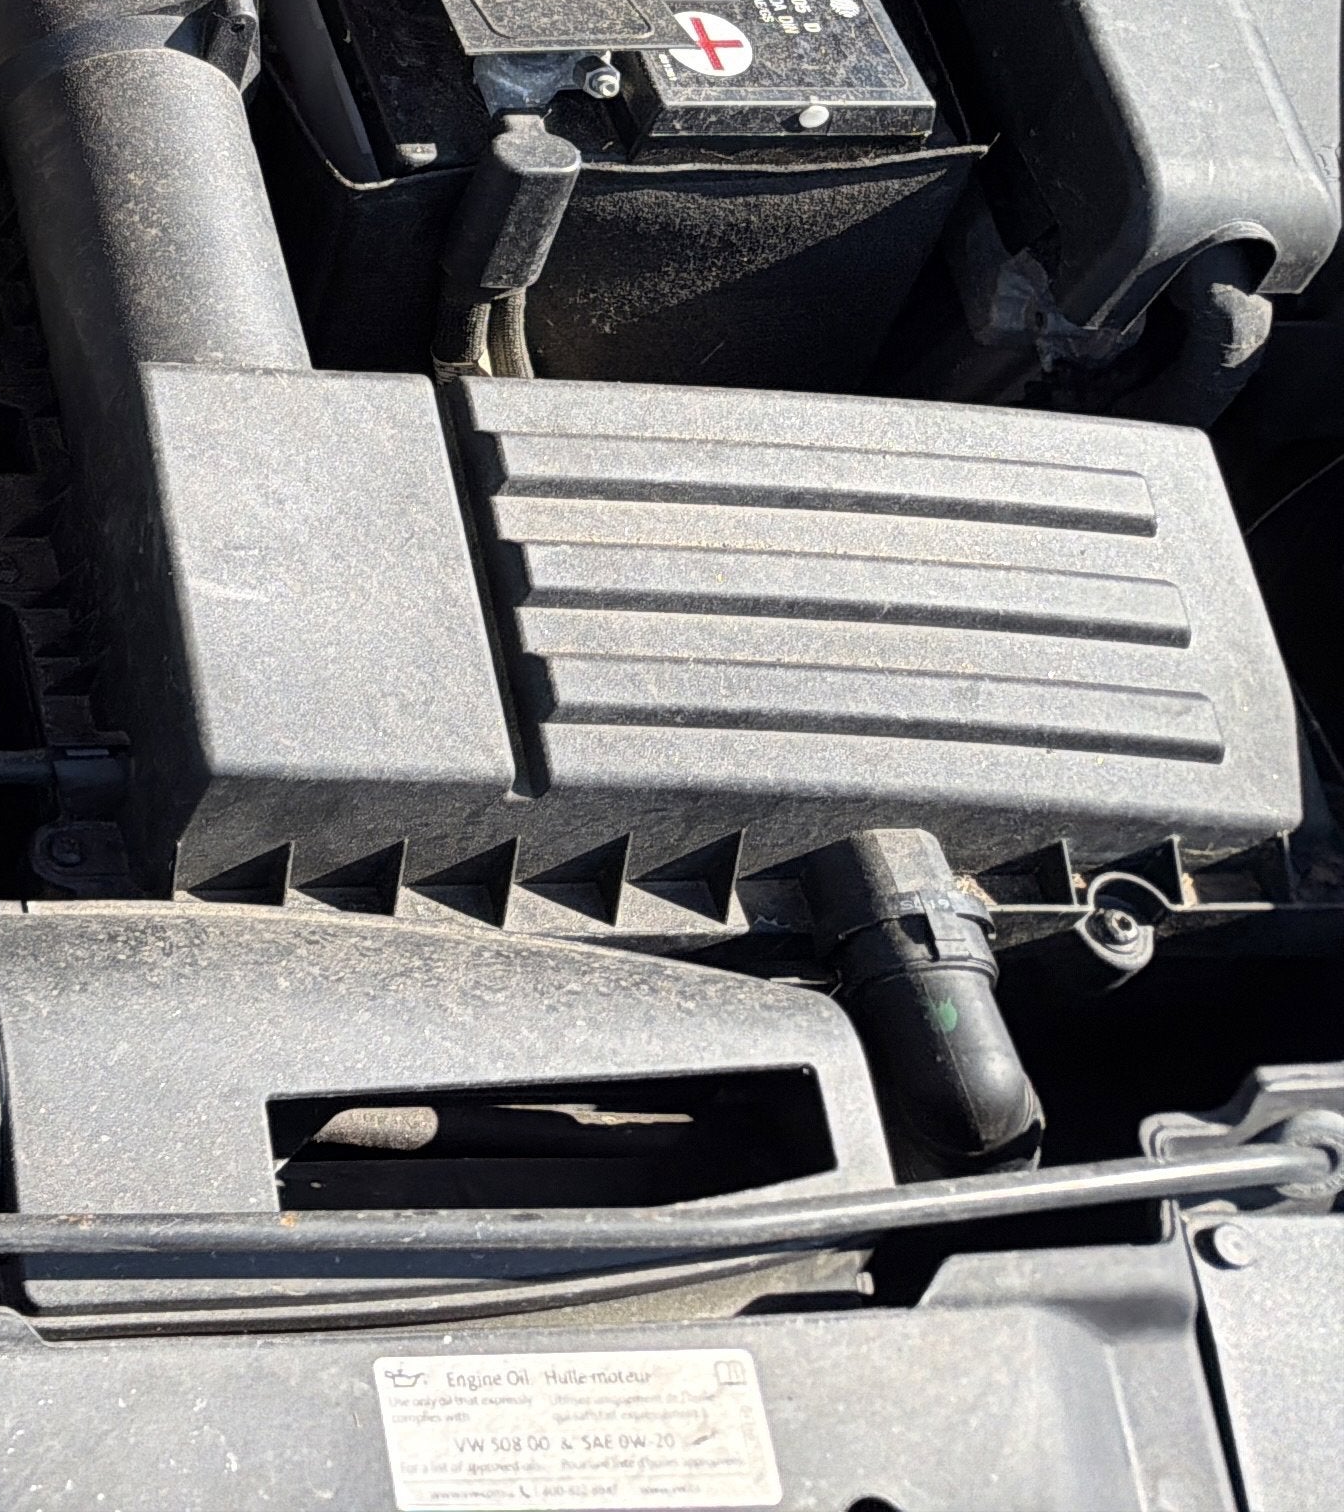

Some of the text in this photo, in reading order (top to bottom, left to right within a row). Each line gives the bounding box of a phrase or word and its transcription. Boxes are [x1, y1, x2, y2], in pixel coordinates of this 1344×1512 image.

[803, 22, 822, 34] D
[446, 1371, 502, 1391] Engine
[453, 1437, 484, 1453] VW
[491, 1437, 523, 1452] 508
[581, 1435, 613, 1450] SAE
